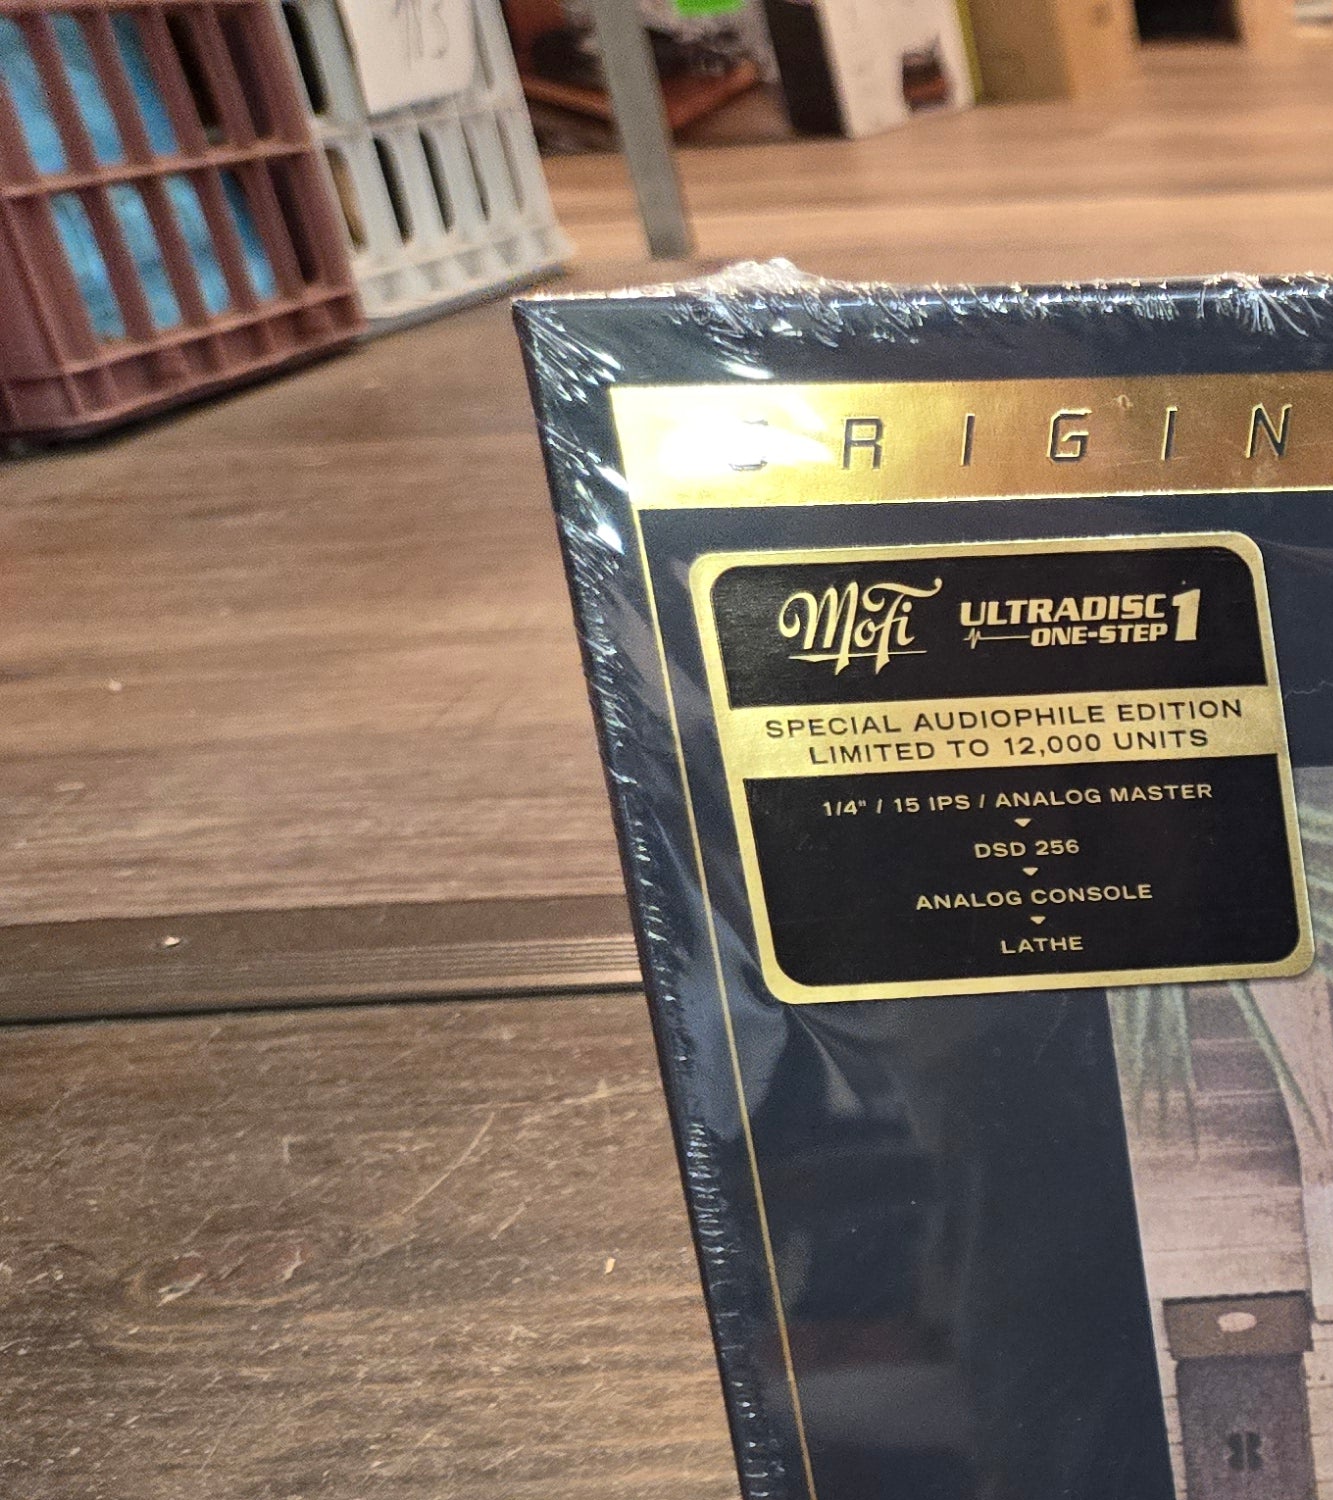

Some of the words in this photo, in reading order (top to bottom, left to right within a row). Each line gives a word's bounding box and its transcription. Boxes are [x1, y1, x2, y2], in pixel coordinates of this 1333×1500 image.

[778, 578, 943, 676] MoFi
[960, 593, 1167, 627] ULTRADISC
[1171, 588, 1202, 642] 1
[1030, 622, 1168, 648] ONE-STEP
[766, 715, 902, 741] SPECIAL
[913, 705, 1105, 733] AUDIOPHILE
[1117, 698, 1243, 723] EDITION
[809, 742, 935, 766] LIMITED
[947, 738, 989, 760] TO
[1003, 733, 1102, 759] 12,000
[1114, 728, 1210, 752] UNITS
[822, 798, 867, 818] 1/4"
[894, 797, 920, 814] 15
[930, 794, 971, 812] IPS
[995, 788, 1102, 808] ANALOG
[1110, 783, 1213, 803] MASTER
[974, 841, 1027, 860] DSD
[1035, 838, 1080, 856] 256
[915, 890, 1022, 911] ANALOG
[1031, 883, 1153, 905] CONSOLE
[1000, 936, 1083, 955] LATHE
